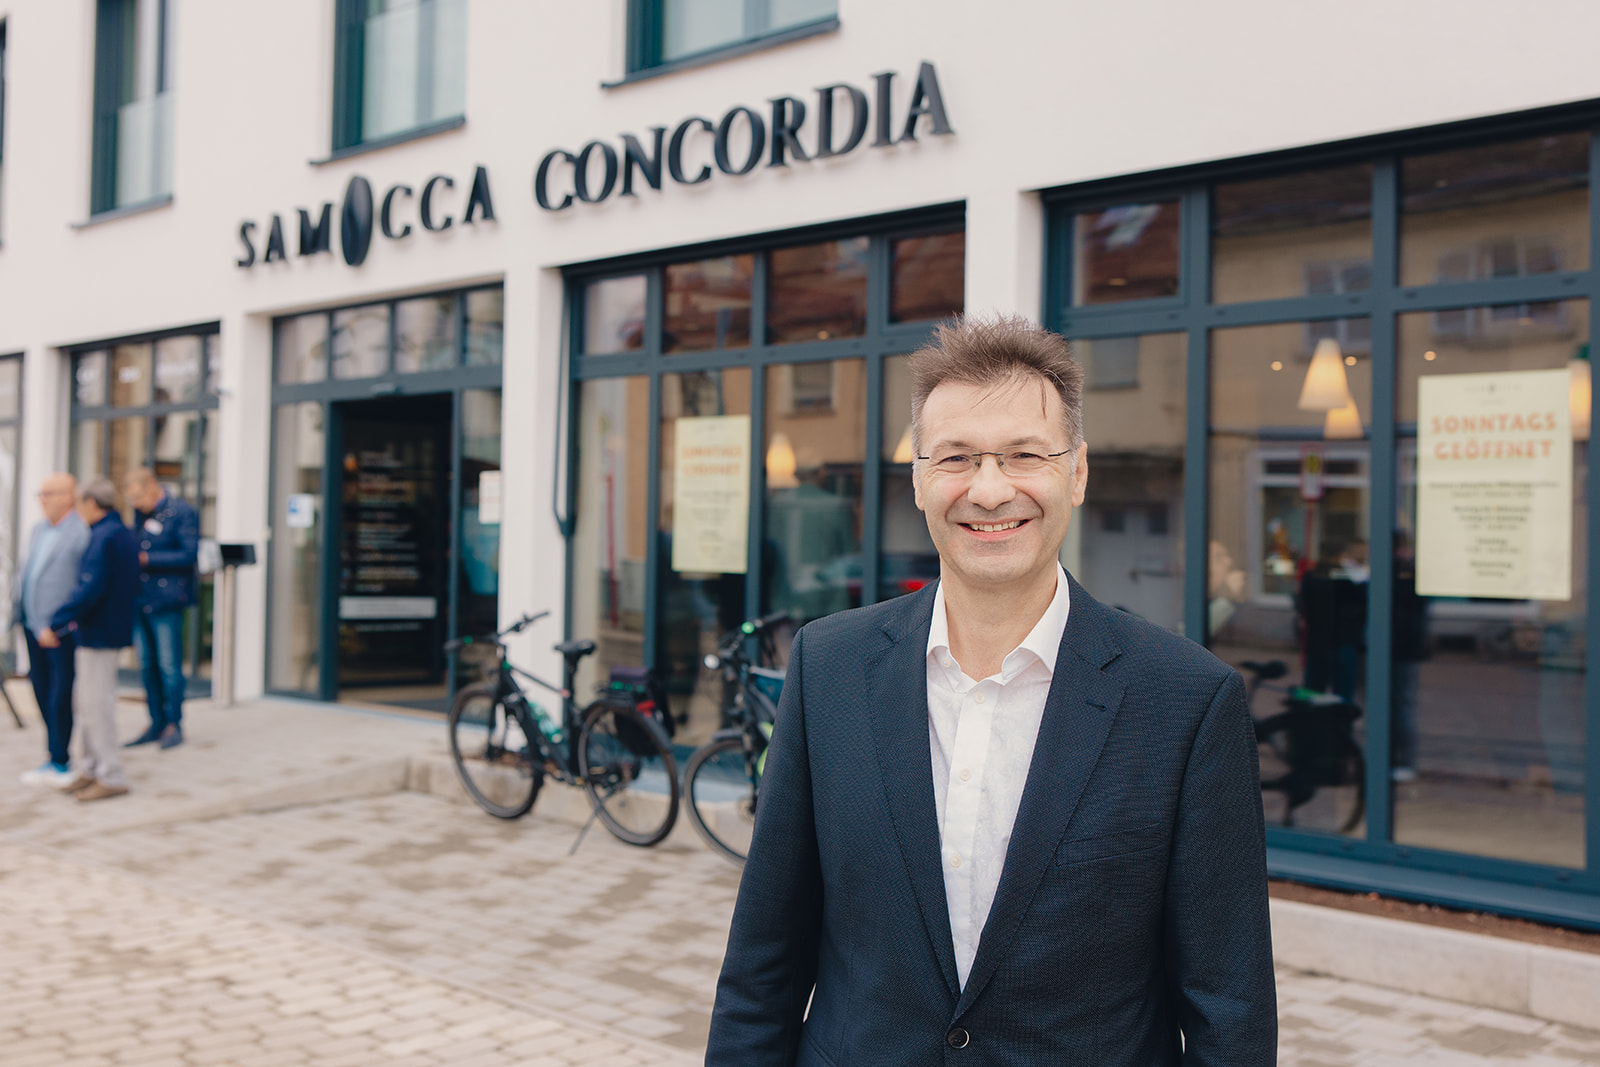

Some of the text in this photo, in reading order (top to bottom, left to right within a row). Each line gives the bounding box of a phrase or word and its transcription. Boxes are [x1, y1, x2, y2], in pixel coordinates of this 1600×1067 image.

[237, 60, 955, 267] SAMOCCA CONCORDIA
[1431, 411, 1557, 434] SONNTAGS
[1433, 437, 1554, 461] GEÖFFNET
